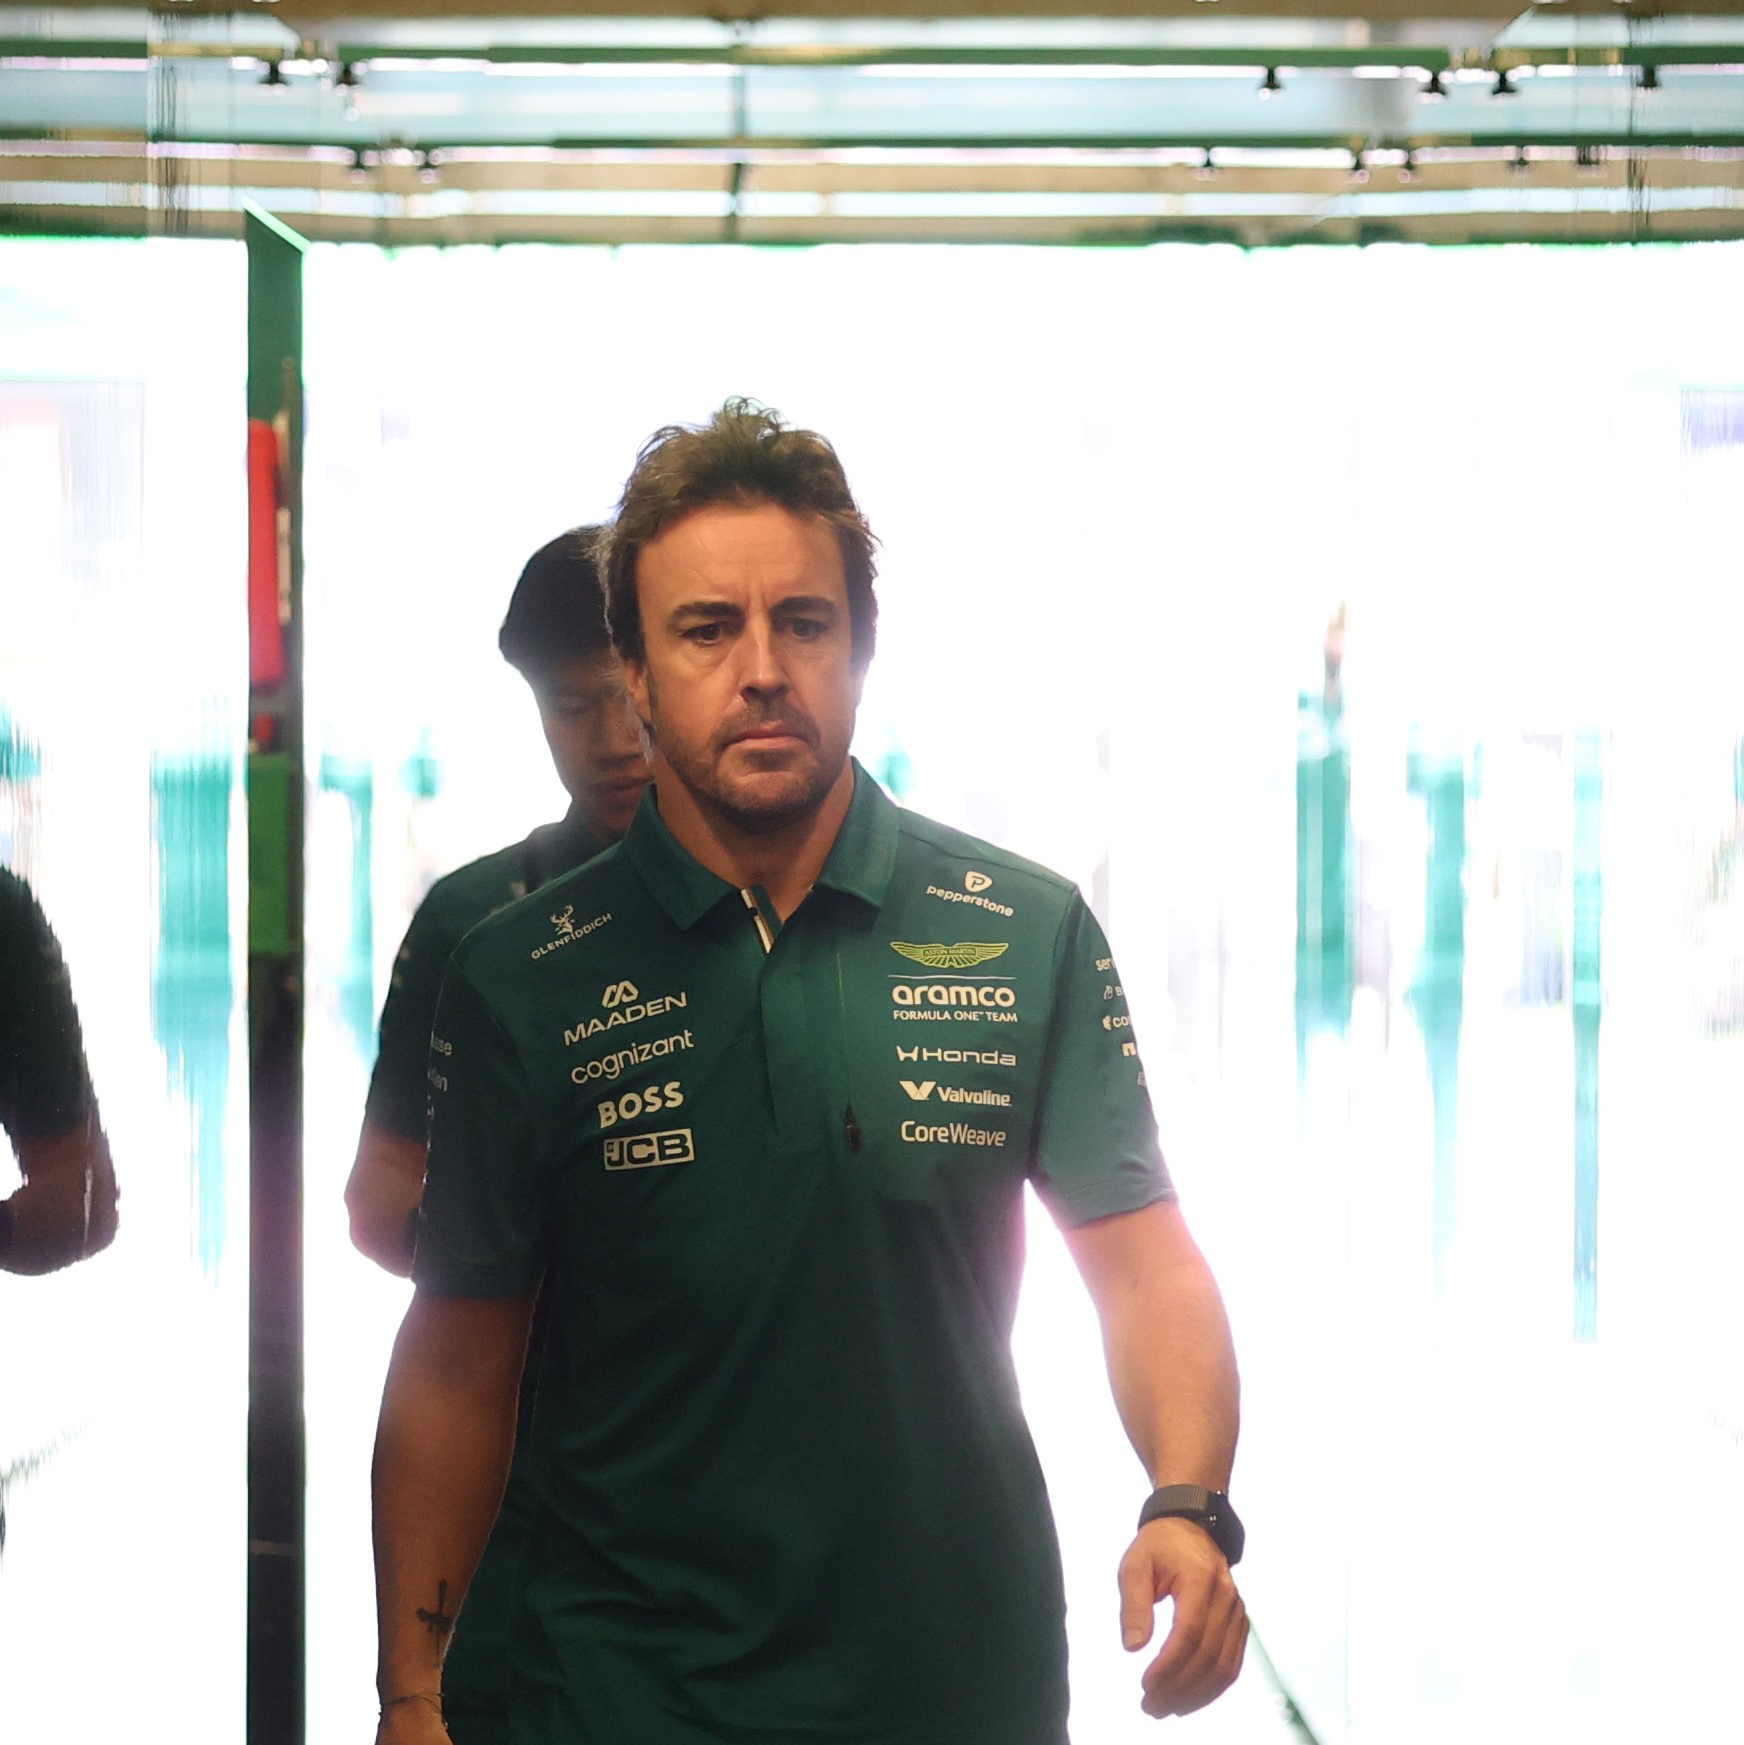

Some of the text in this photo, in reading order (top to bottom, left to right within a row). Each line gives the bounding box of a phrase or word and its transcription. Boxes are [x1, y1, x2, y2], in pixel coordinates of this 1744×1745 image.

[926, 885, 1014, 917] pepperstone
[531, 912, 613, 960] GLENFIDDICH
[892, 985, 1016, 1007] aramco
[564, 992, 688, 1046] MAADEN
[893, 1010, 952, 1020] FORMULA
[985, 1011, 1018, 1022] TEAM
[571, 1029, 695, 1084] cognizant
[922, 1048, 1017, 1067] Honda
[597, 1081, 684, 1129] BOSS
[937, 1086, 1012, 1107] Valvoline
[900, 1120, 1007, 1147] CoreWeave
[606, 1133, 691, 1167] JCB
